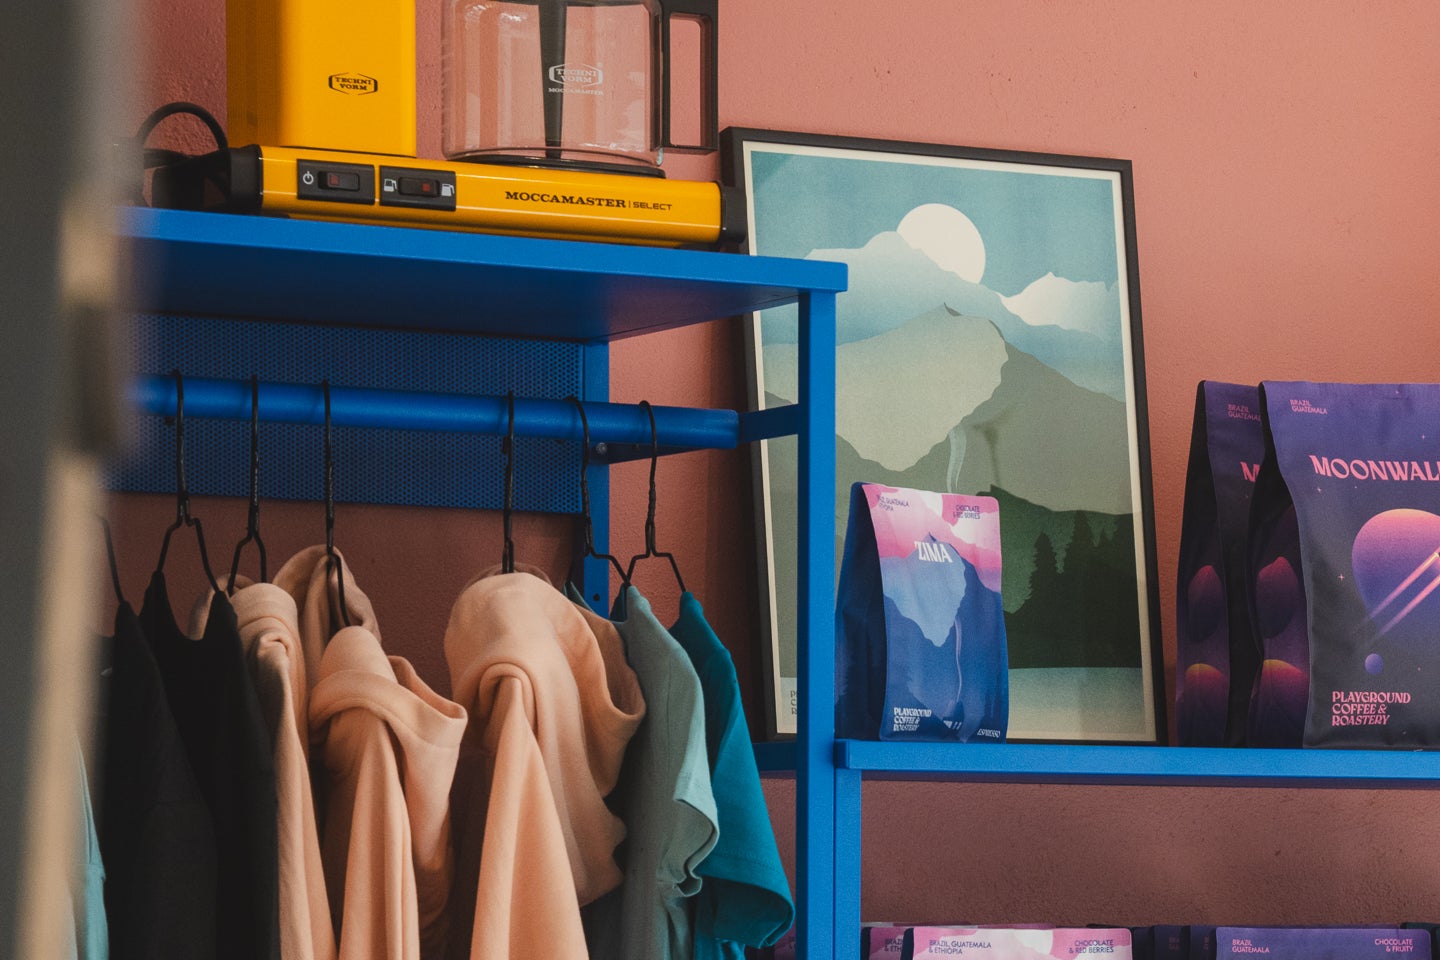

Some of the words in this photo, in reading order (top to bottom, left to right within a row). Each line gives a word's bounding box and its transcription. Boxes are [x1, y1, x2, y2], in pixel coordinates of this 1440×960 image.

[505, 191, 626, 208] MOCCAMASTER
[633, 202, 672, 210] SELECT
[1292, 406, 1327, 415] GUATEMALA
[914, 541, 952, 563] ZIMA
[1332, 692, 1411, 704] PLAYGROUND
[1332, 704, 1376, 714] COFFEE
[1378, 704, 1387, 714] &
[1332, 715, 1390, 726] ROASTERY
[952, 940, 992, 948] GUATEMALA
[1374, 938, 1413, 946] CHOCOLATE
